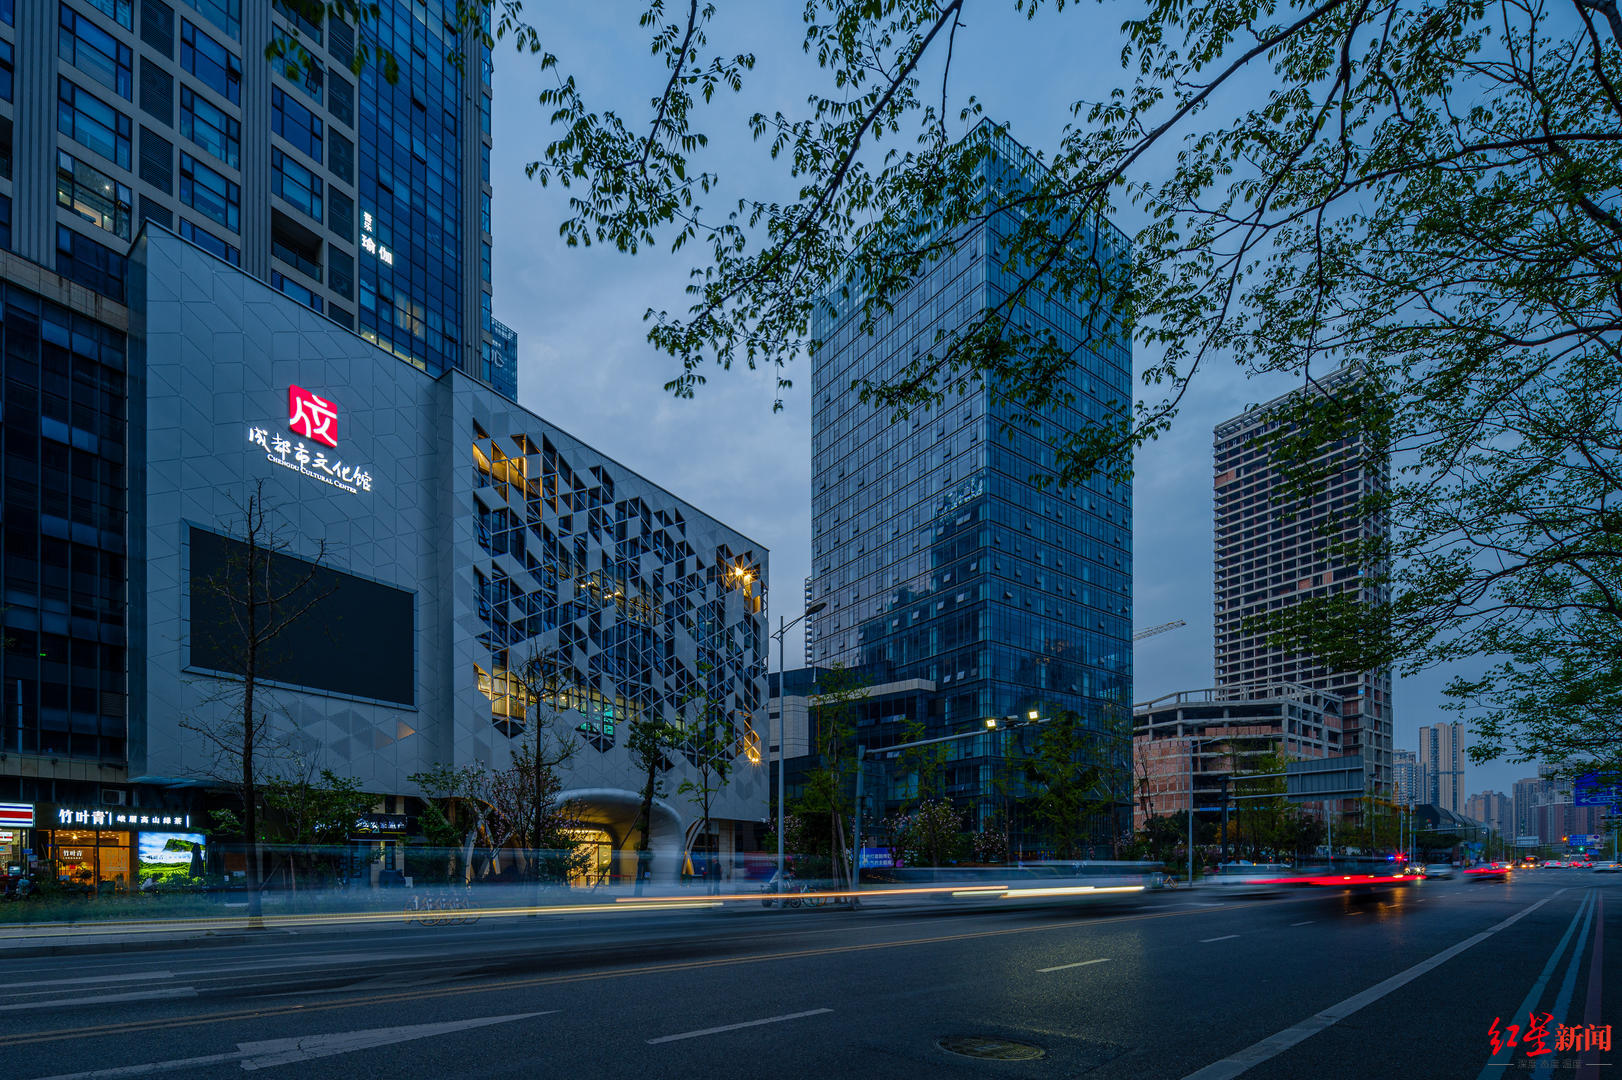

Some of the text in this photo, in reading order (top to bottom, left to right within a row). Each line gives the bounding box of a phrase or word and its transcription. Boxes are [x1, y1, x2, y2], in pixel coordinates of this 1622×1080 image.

[361, 233, 393, 266] 瑜伽
[248, 426, 373, 492] 成都市文化馆
[267, 453, 358, 495] CHENGDU CULTURAL CENTER
[59, 808, 107, 826] 竹叶青
[116, 814, 183, 826] 峨眉高山绿茶
